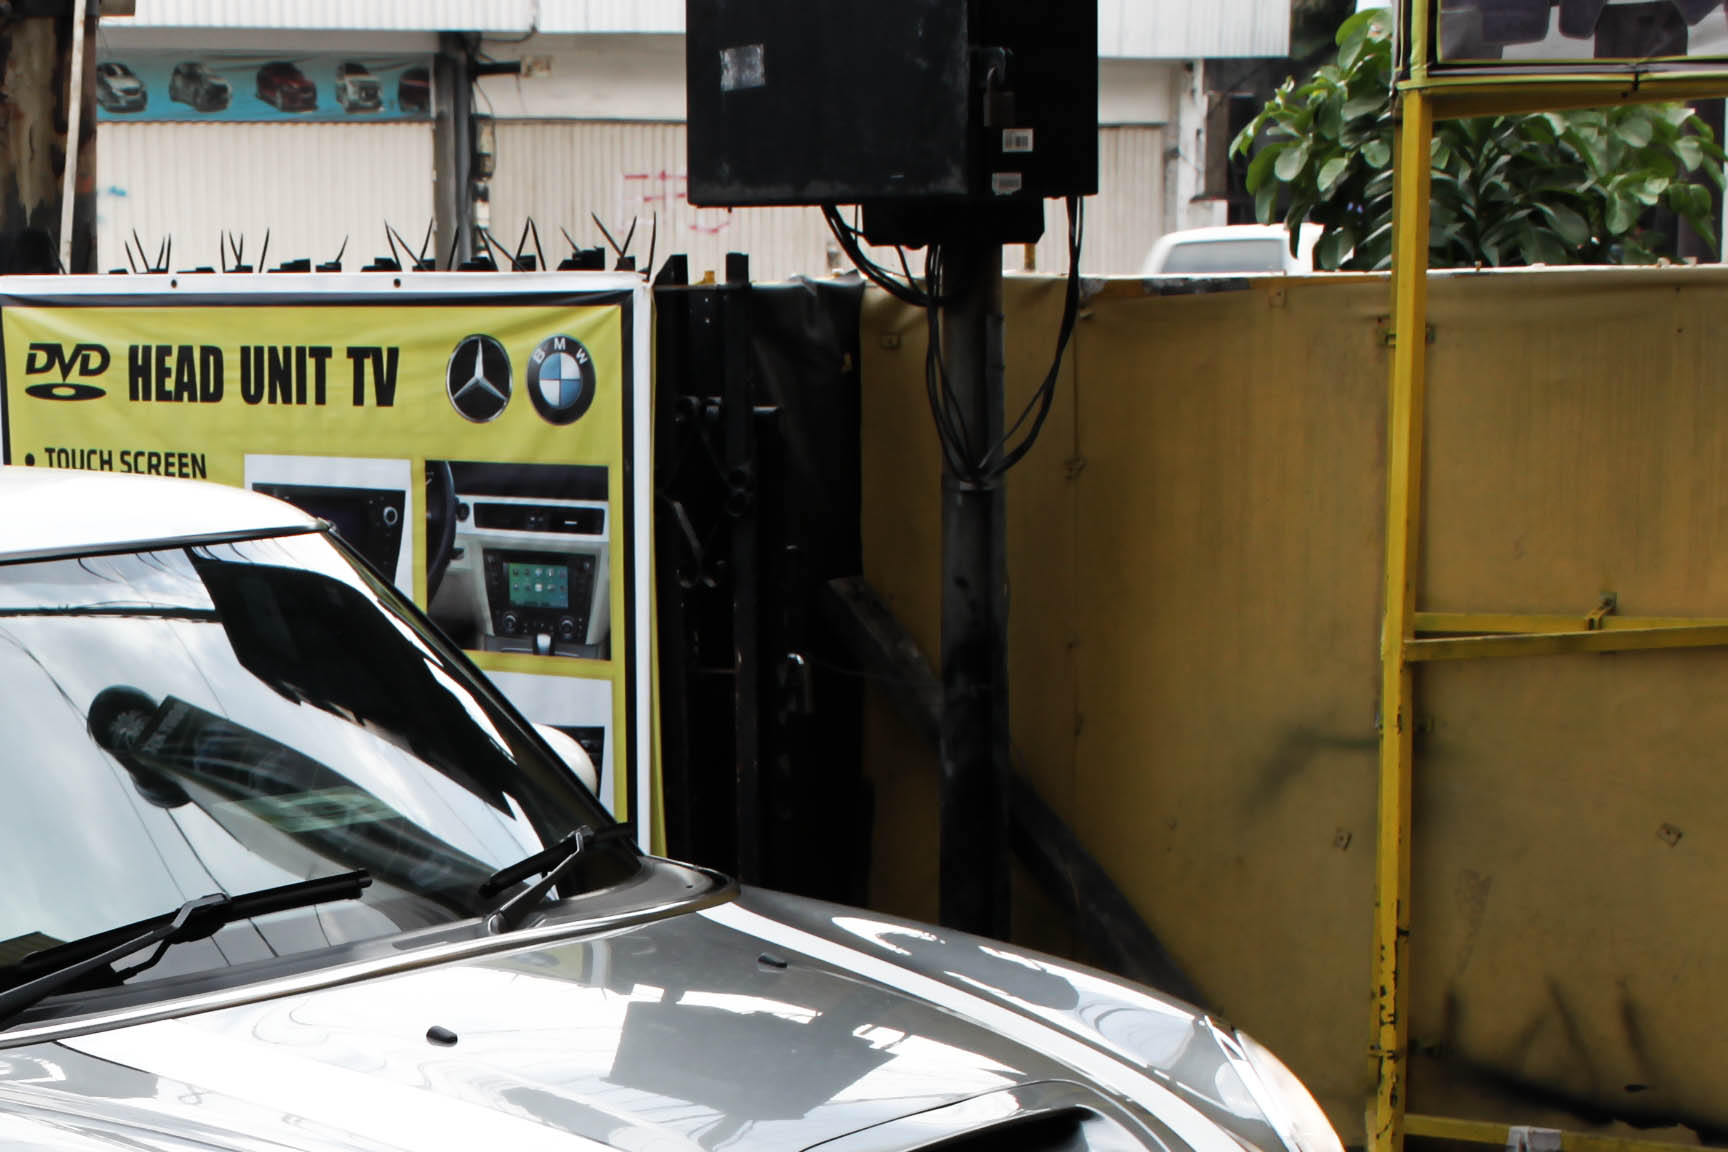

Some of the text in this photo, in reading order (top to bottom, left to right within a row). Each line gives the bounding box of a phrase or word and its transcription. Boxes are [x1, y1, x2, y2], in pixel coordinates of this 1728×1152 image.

[533, 336, 589, 365] BMW
[24, 342, 400, 408] DVD HEAD UNIT TV
[44, 447, 208, 480] TOUCH SCREEN
